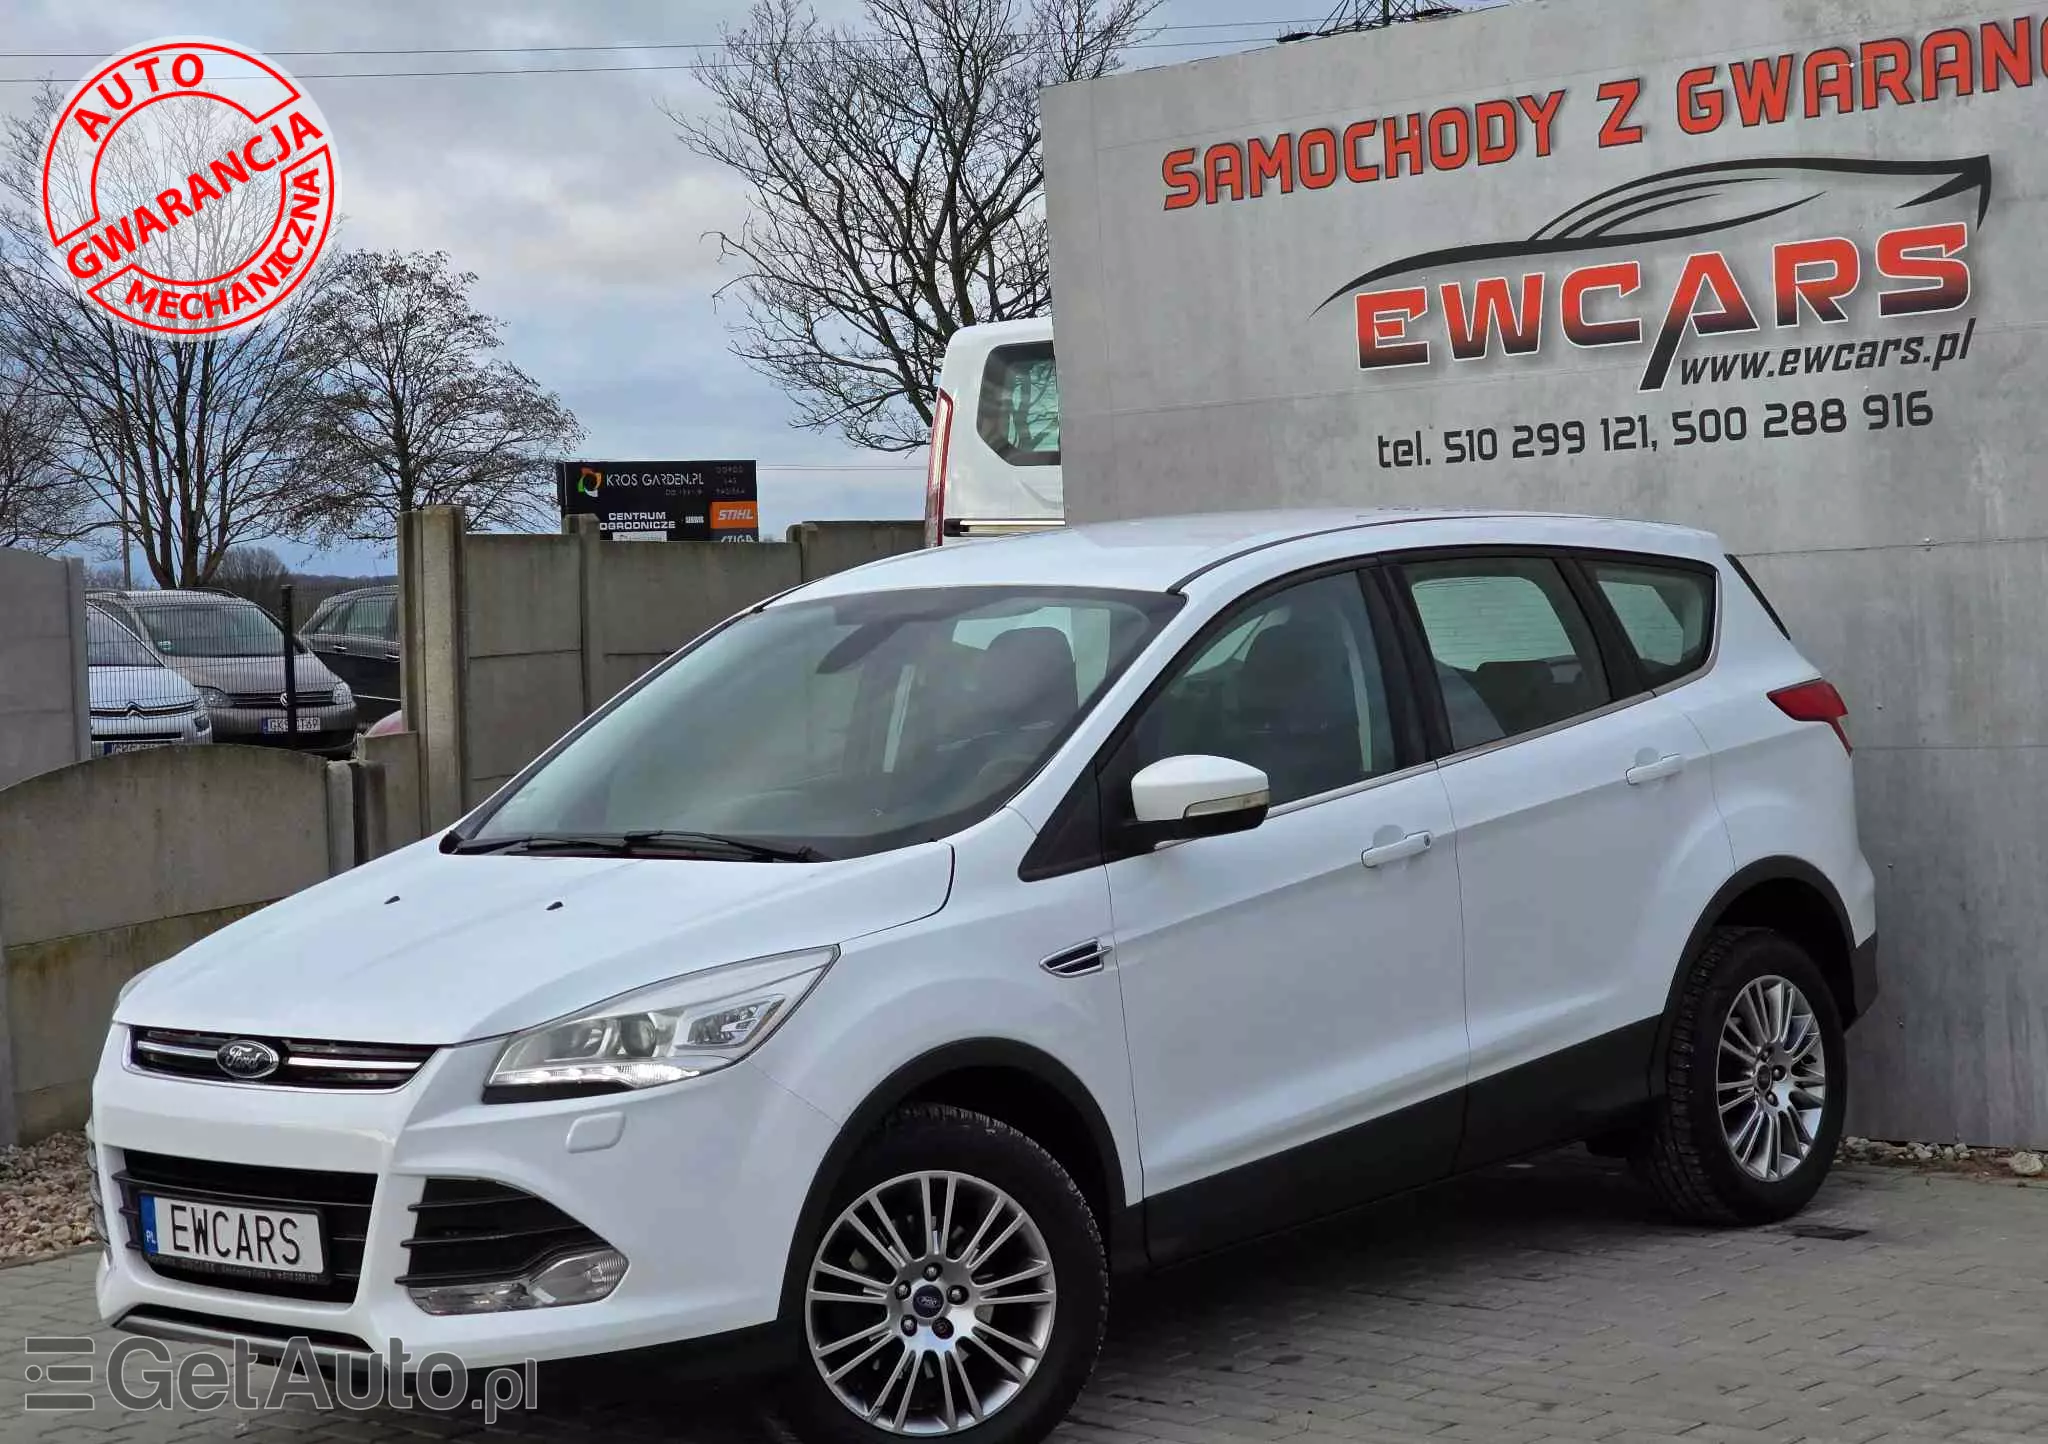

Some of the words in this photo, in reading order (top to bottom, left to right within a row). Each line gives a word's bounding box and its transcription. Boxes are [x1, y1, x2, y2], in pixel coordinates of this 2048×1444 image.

[1162, 88, 1566, 211] SAMOCHODY
[1597, 78, 1643, 149] Z
[1676, 15, 2048, 136] GWARAN
[1355, 222, 1971, 392] EWCARS
[1679, 317, 1976, 386] www.ewcars.pl
[1377, 430, 1431, 468] tel.
[1445, 426, 1498, 464] 510
[1512, 419, 1585, 459] 299
[1600, 413, 1658, 453] 121,
[1673, 404, 1748, 446] 500
[1765, 397, 1847, 439] 288
[1864, 389, 1934, 430] 916
[606, 473, 638, 487] KROS
[641, 473, 704, 486] GARDEN.PL
[600, 521, 676, 531] OGRODNICZE
[608, 511, 667, 521] CENTRUM
[718, 509, 754, 521] STIHL
[225, 1045, 265, 1068] Ford
[145, 1229, 158, 1244] PL
[170, 1204, 301, 1265] EWCARS
